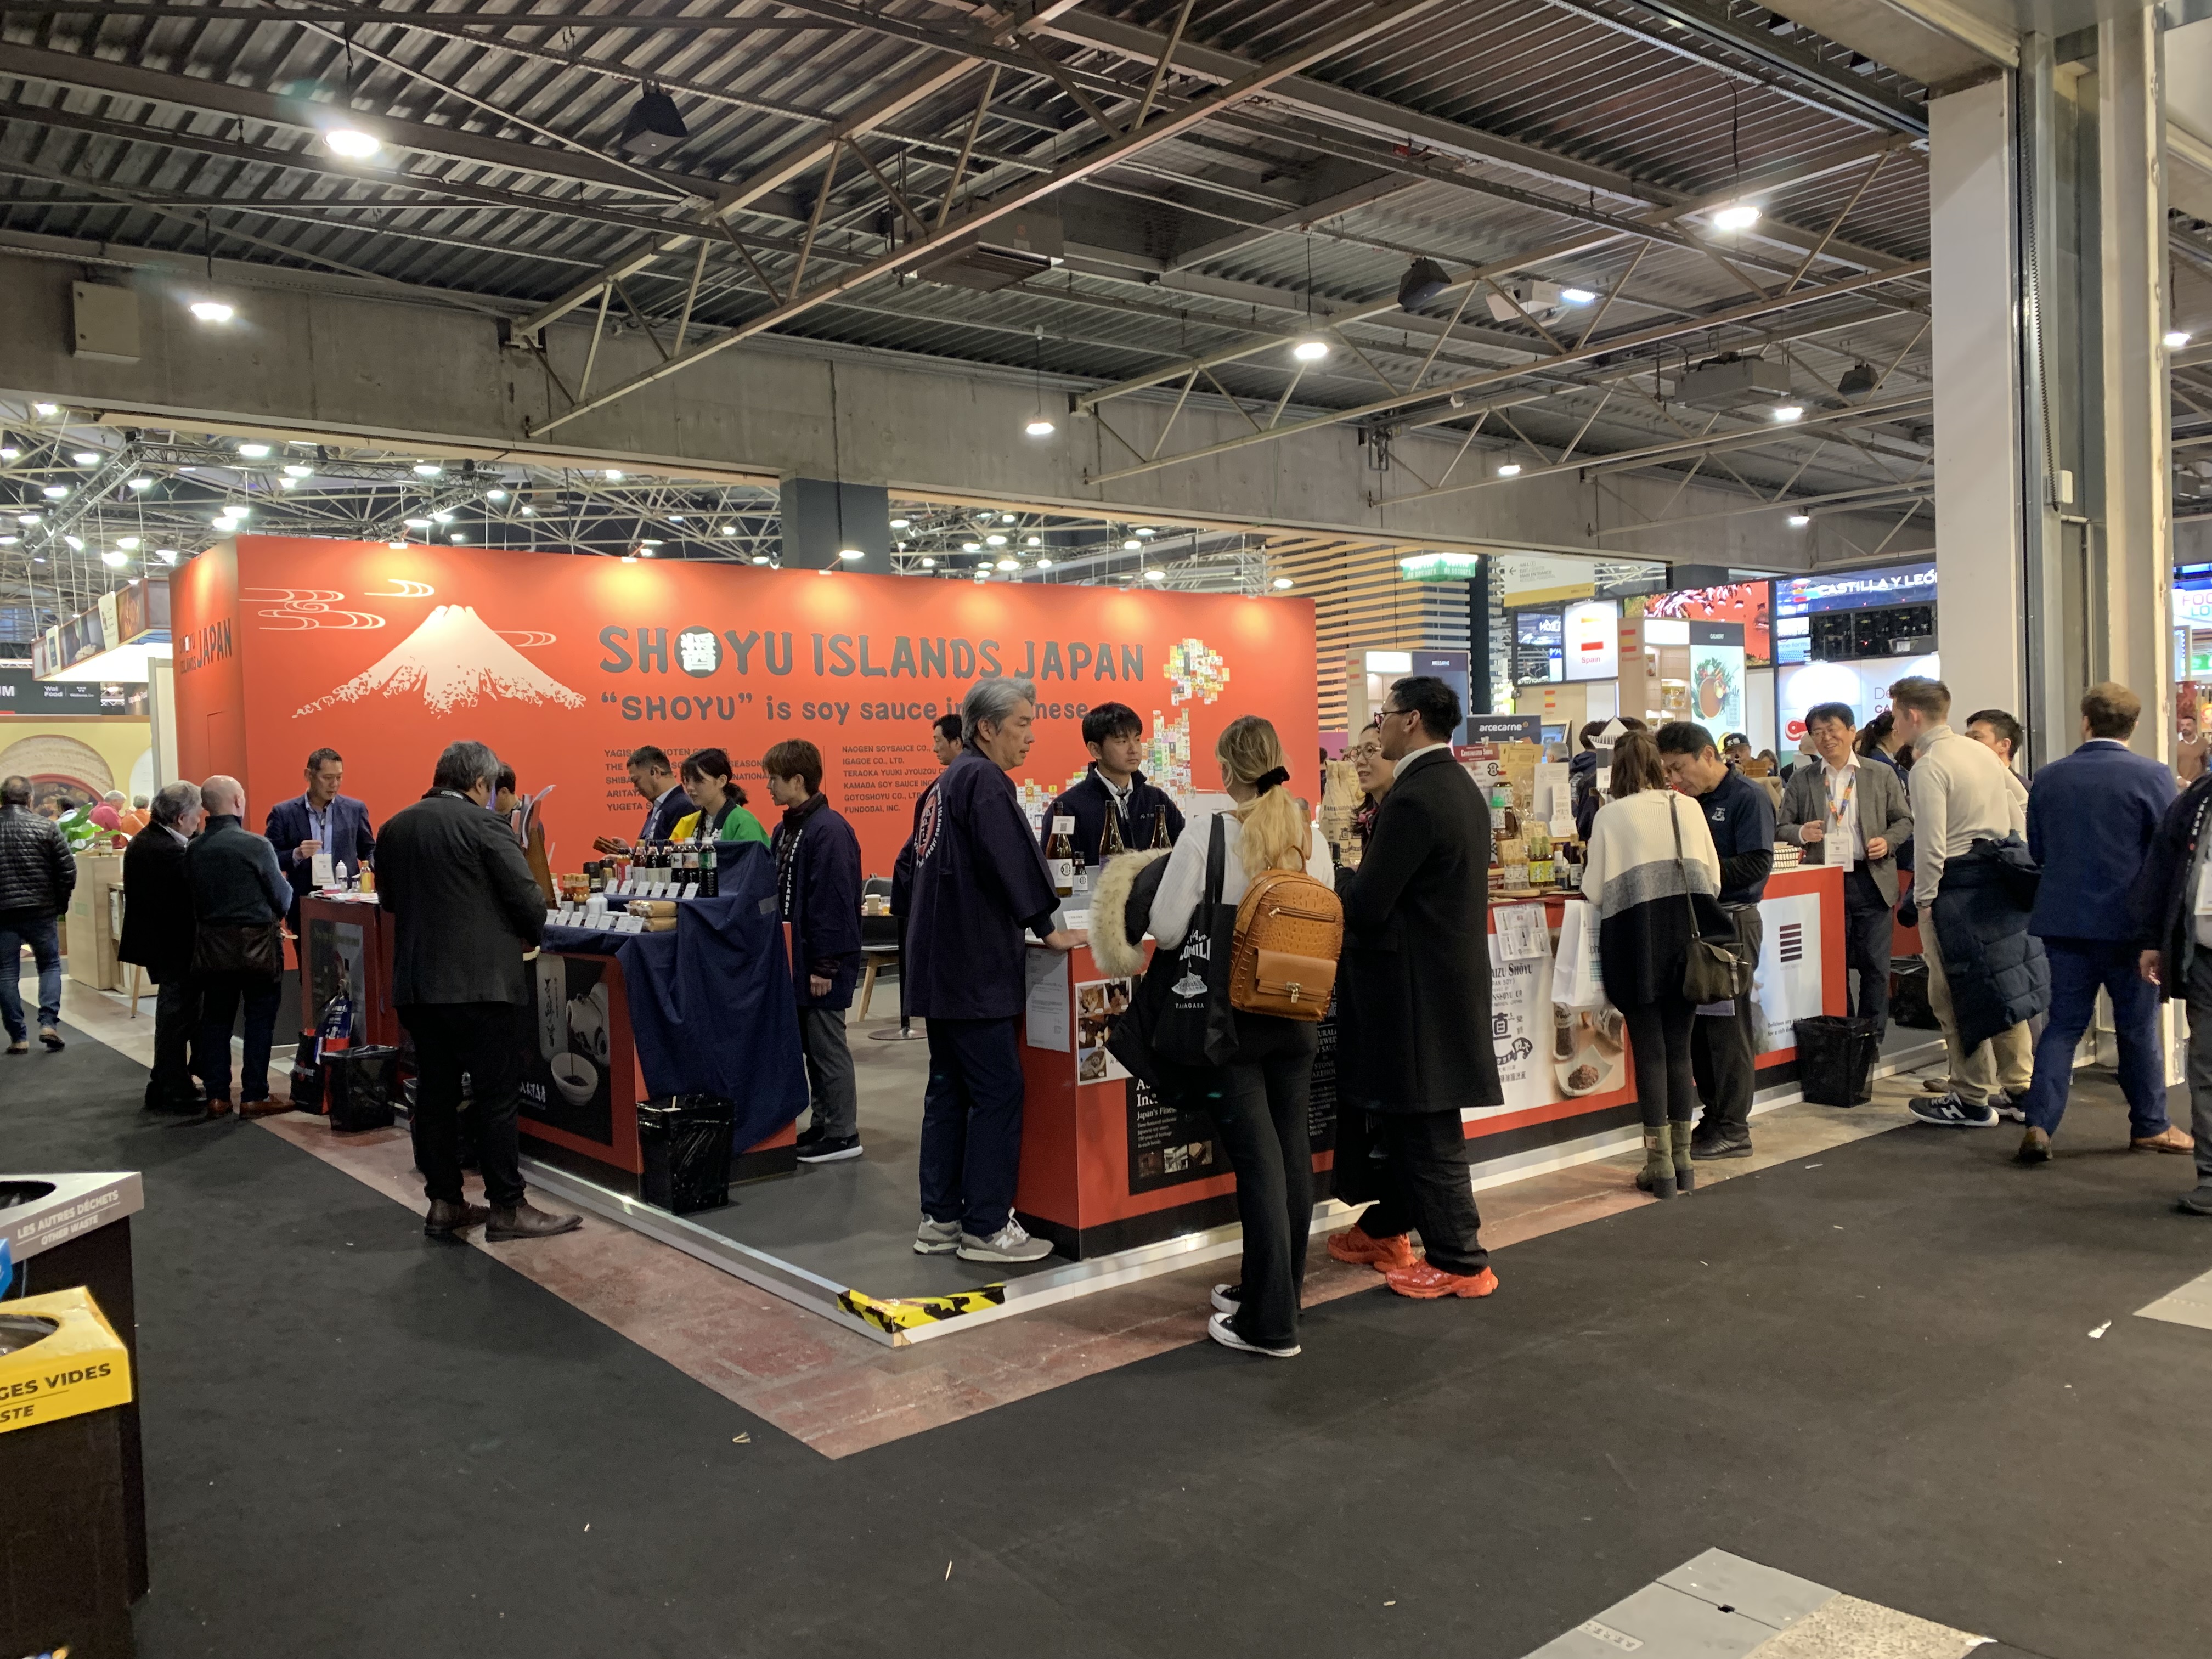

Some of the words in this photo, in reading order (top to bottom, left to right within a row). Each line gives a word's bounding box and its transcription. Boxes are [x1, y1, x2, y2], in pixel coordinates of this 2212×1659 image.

[1818, 578, 1888, 596] CASTILLA
[1892, 576, 1901, 588] Y
[196, 617, 232, 669] JAPAN
[811, 633, 1002, 679] ISLANDS
[1015, 640, 1144, 681] JAPAN
[1582, 656, 1600, 665] Spain
[766, 695, 792, 720] is
[802, 701, 850, 725] soy
[860, 700, 937, 720] sauce
[1034, 702, 1089, 720] nese
[1479, 723, 1522, 732] arcecarne
[606, 803, 643, 811] YUGETA
[844, 793, 890, 802] GOTOSHOYU
[789, 829, 803, 863] SHOYU
[925, 837, 938, 859] JAPAN
[1137, 1108, 1159, 1121] Japan's
[17, 1223, 36, 1239] LES
[38, 1207, 76, 1232] AUTRES
[77, 1190, 119, 1215] DÉCHETS
[41, 1226, 69, 1246] OTHER
[71, 1214, 99, 1233] WASTE
[44, 1363, 111, 1390] VIDES
